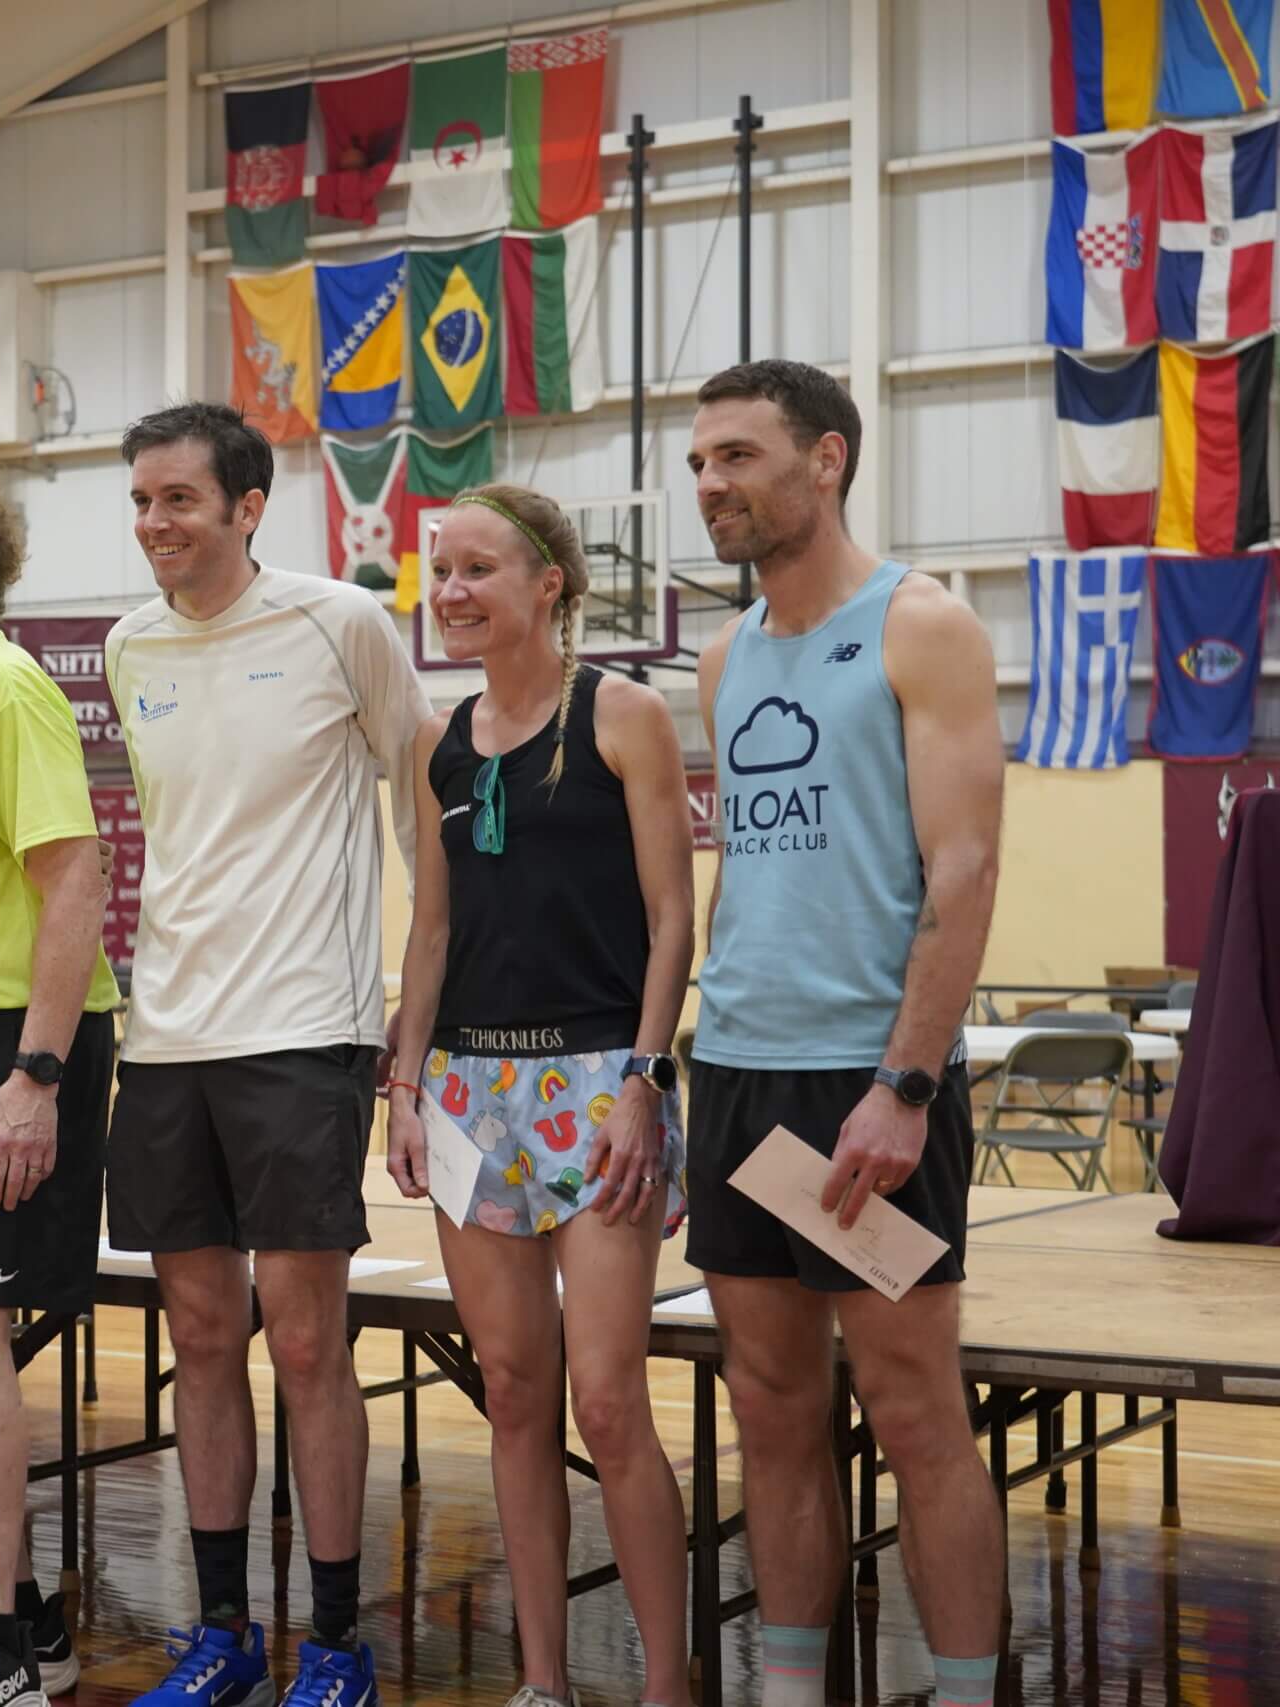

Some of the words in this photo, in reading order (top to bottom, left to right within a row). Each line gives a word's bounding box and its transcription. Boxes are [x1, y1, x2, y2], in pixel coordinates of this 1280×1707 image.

[41, 651, 103, 675] NHTI
[140, 701, 178, 720] OUTFITTERS
[725, 836, 771, 857] RACK
[778, 832, 828, 851] CLUB
[471, 1027, 564, 1051] CHICKNLEGS
